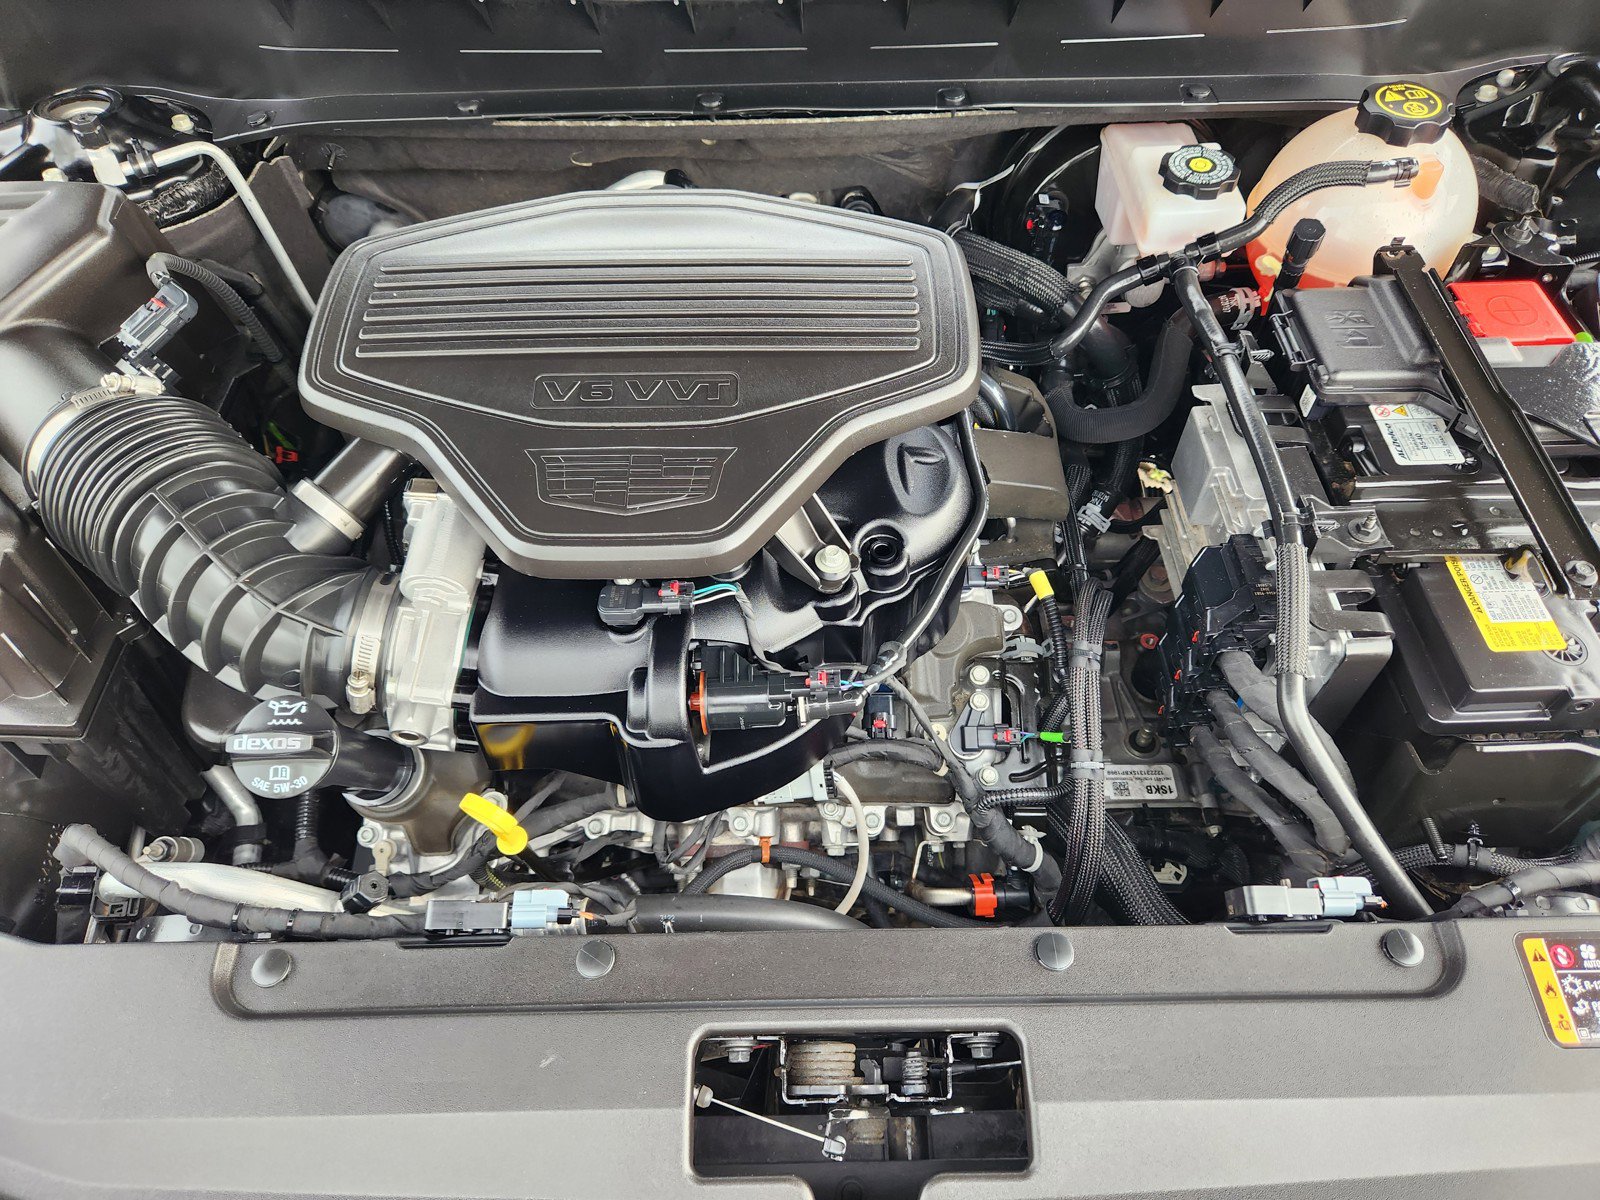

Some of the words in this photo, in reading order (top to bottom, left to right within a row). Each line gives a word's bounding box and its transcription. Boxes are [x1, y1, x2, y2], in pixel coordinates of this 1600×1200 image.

[542, 379, 614, 402] V6
[624, 378, 731, 401] VVT
[1385, 422, 1408, 460] ACDelco
[1459, 578, 1480, 606] DANGER
[233, 735, 302, 751] dexos
[251, 777, 271, 792] SAE
[273, 775, 308, 793] 5W-30
[1146, 784, 1174, 795] 1SKB
